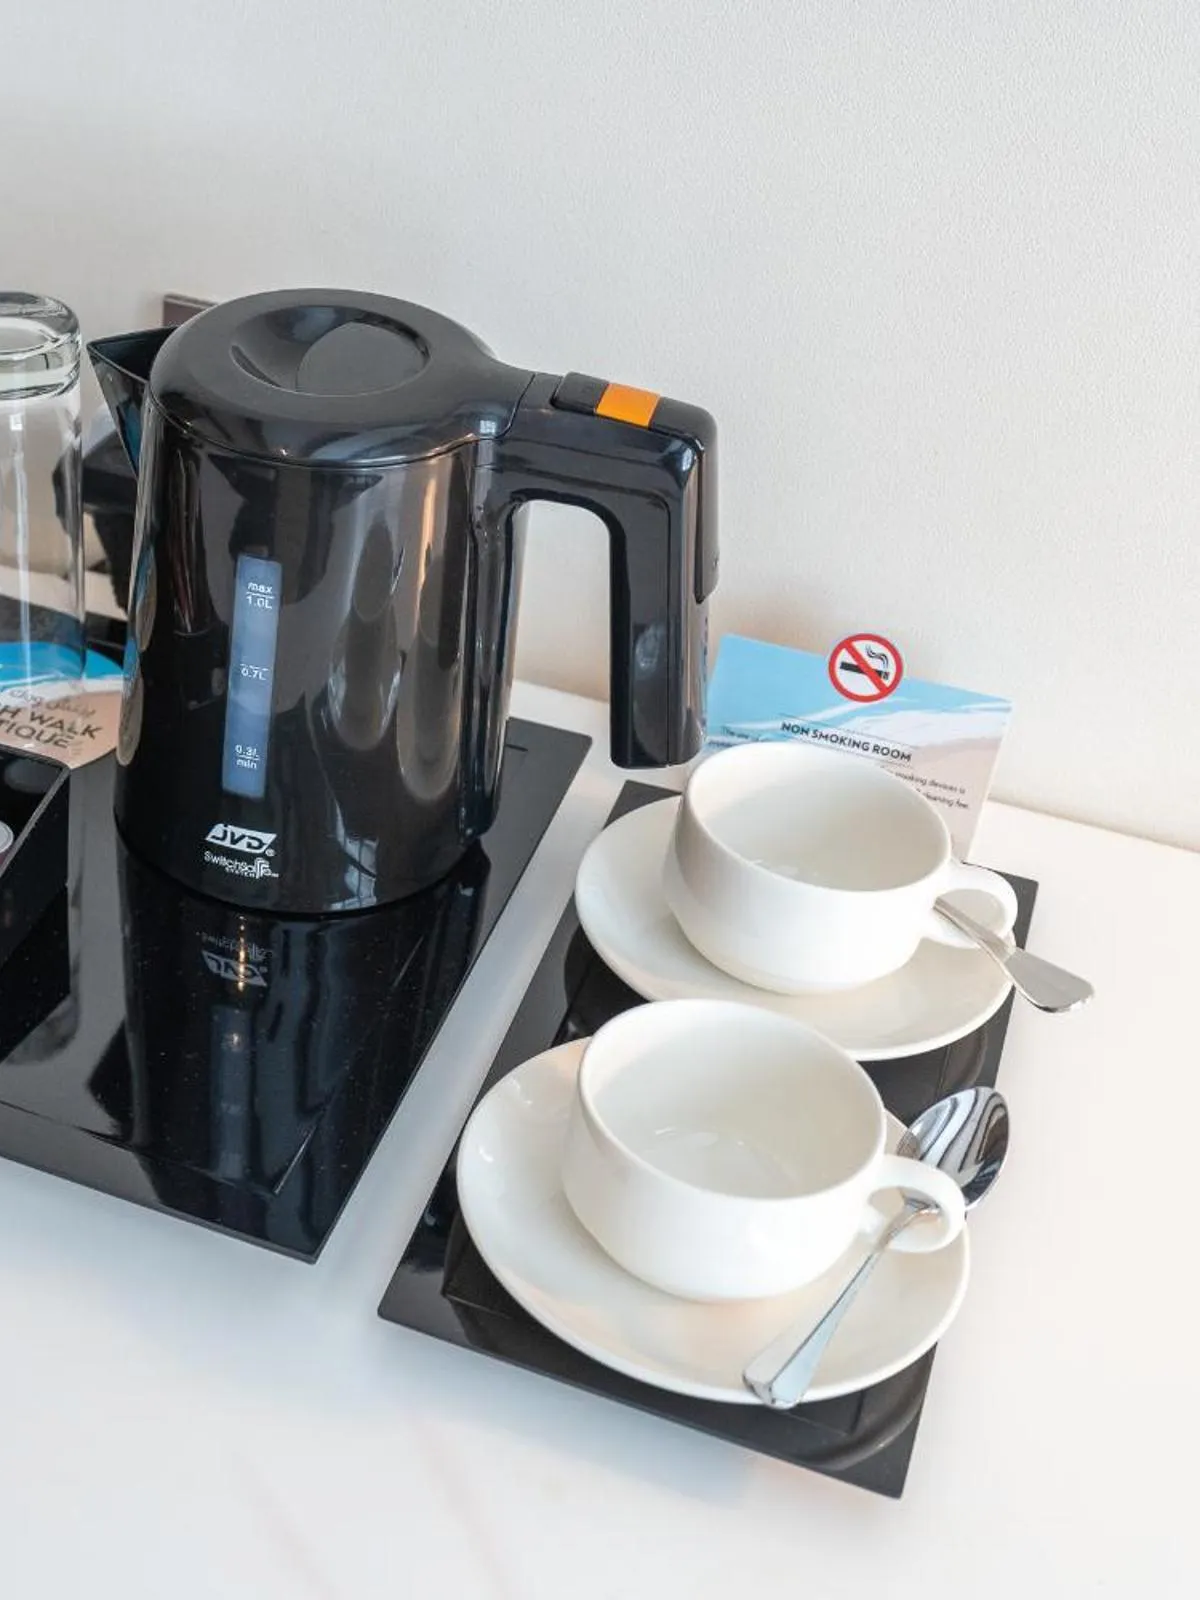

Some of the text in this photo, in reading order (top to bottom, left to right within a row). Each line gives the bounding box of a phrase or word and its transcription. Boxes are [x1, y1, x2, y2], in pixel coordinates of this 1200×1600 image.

[247, 582, 273, 594] max
[246, 596, 273, 610] 1.0L
[30, 711, 103, 740] WALK
[781, 721, 912, 762] NON SMOKING ROOM
